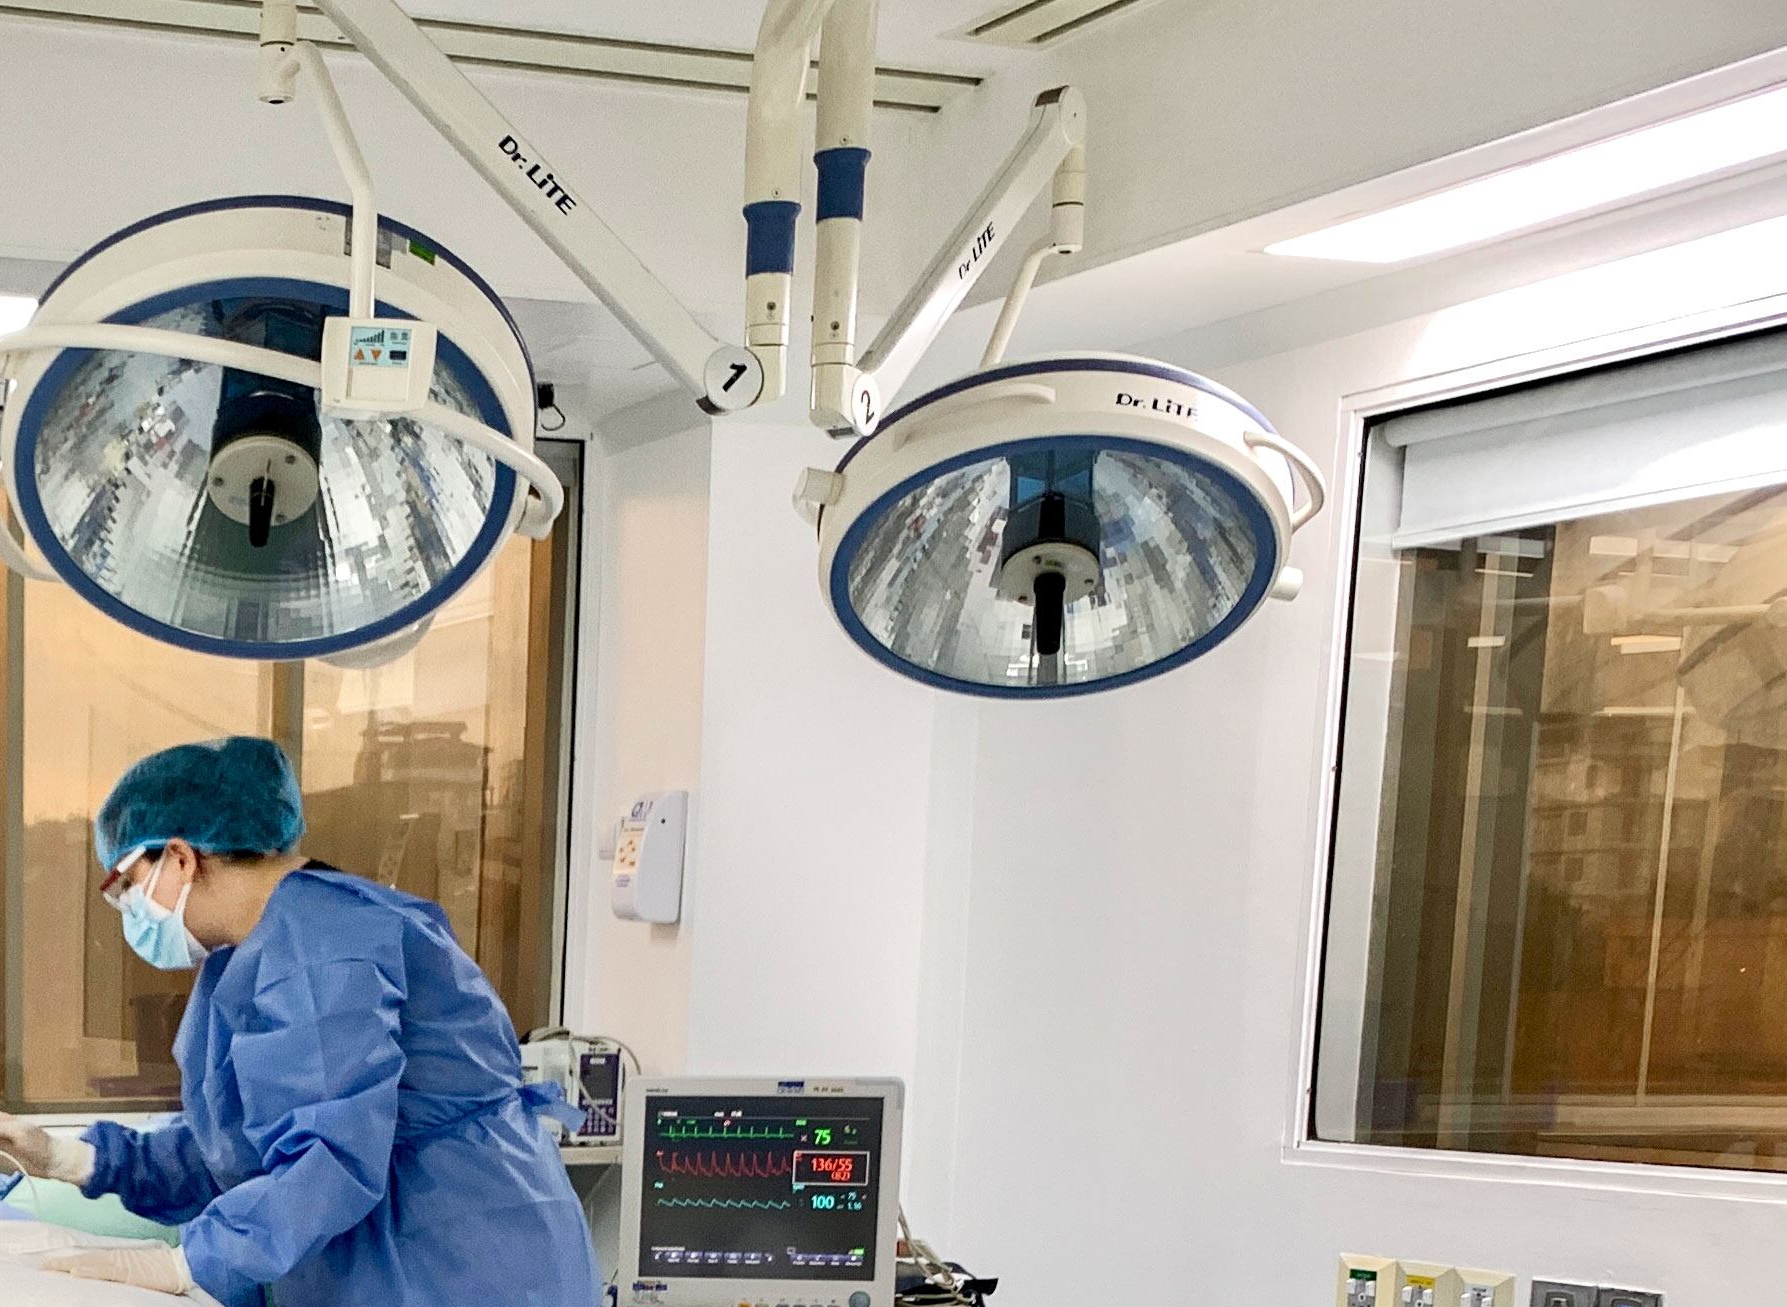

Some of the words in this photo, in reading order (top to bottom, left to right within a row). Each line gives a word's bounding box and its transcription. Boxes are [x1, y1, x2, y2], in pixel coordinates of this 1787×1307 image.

[498, 134, 528, 169] Dr.
[722, 362, 748, 393] 1
[861, 390, 875, 425] 2
[814, 1128, 832, 1145] 75
[811, 1158, 853, 1172] 136/55
[811, 1194, 836, 1210] 100
